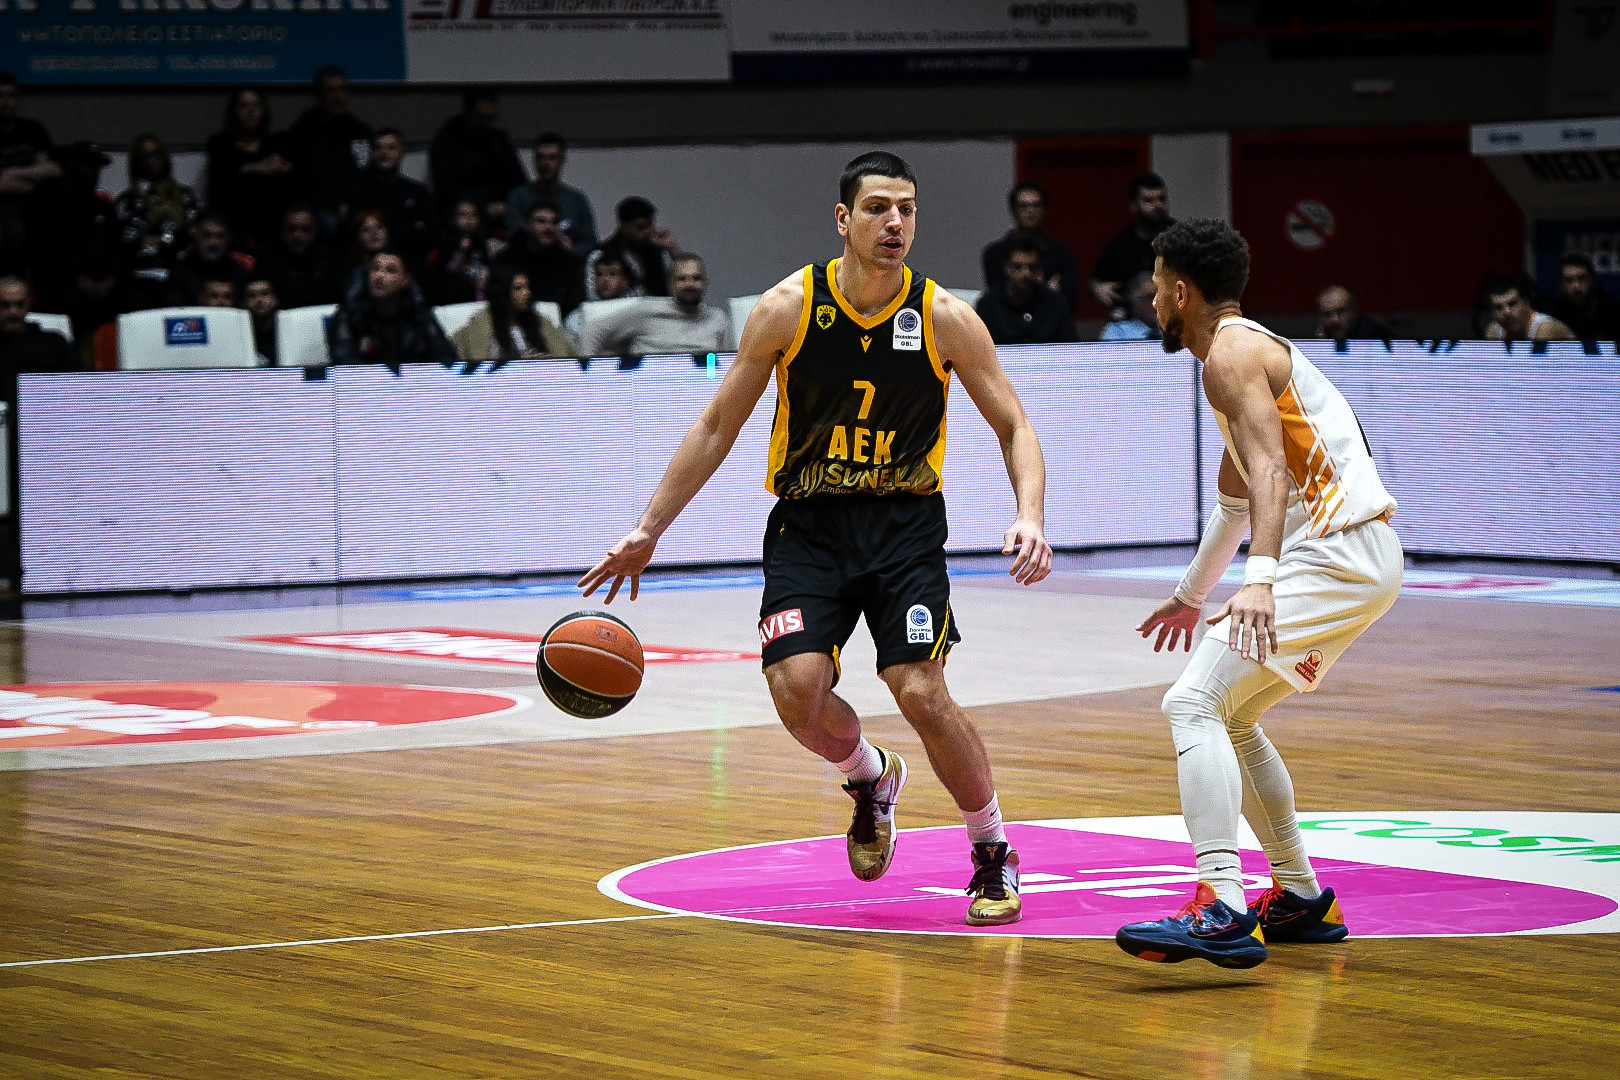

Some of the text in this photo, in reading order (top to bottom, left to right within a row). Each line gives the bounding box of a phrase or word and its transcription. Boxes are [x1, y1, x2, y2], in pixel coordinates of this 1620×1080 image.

[853, 380, 876, 419] 7
[827, 425, 896, 465] AEK
[825, 463, 911, 489] SUNEL
[910, 632, 932, 641] GBL
